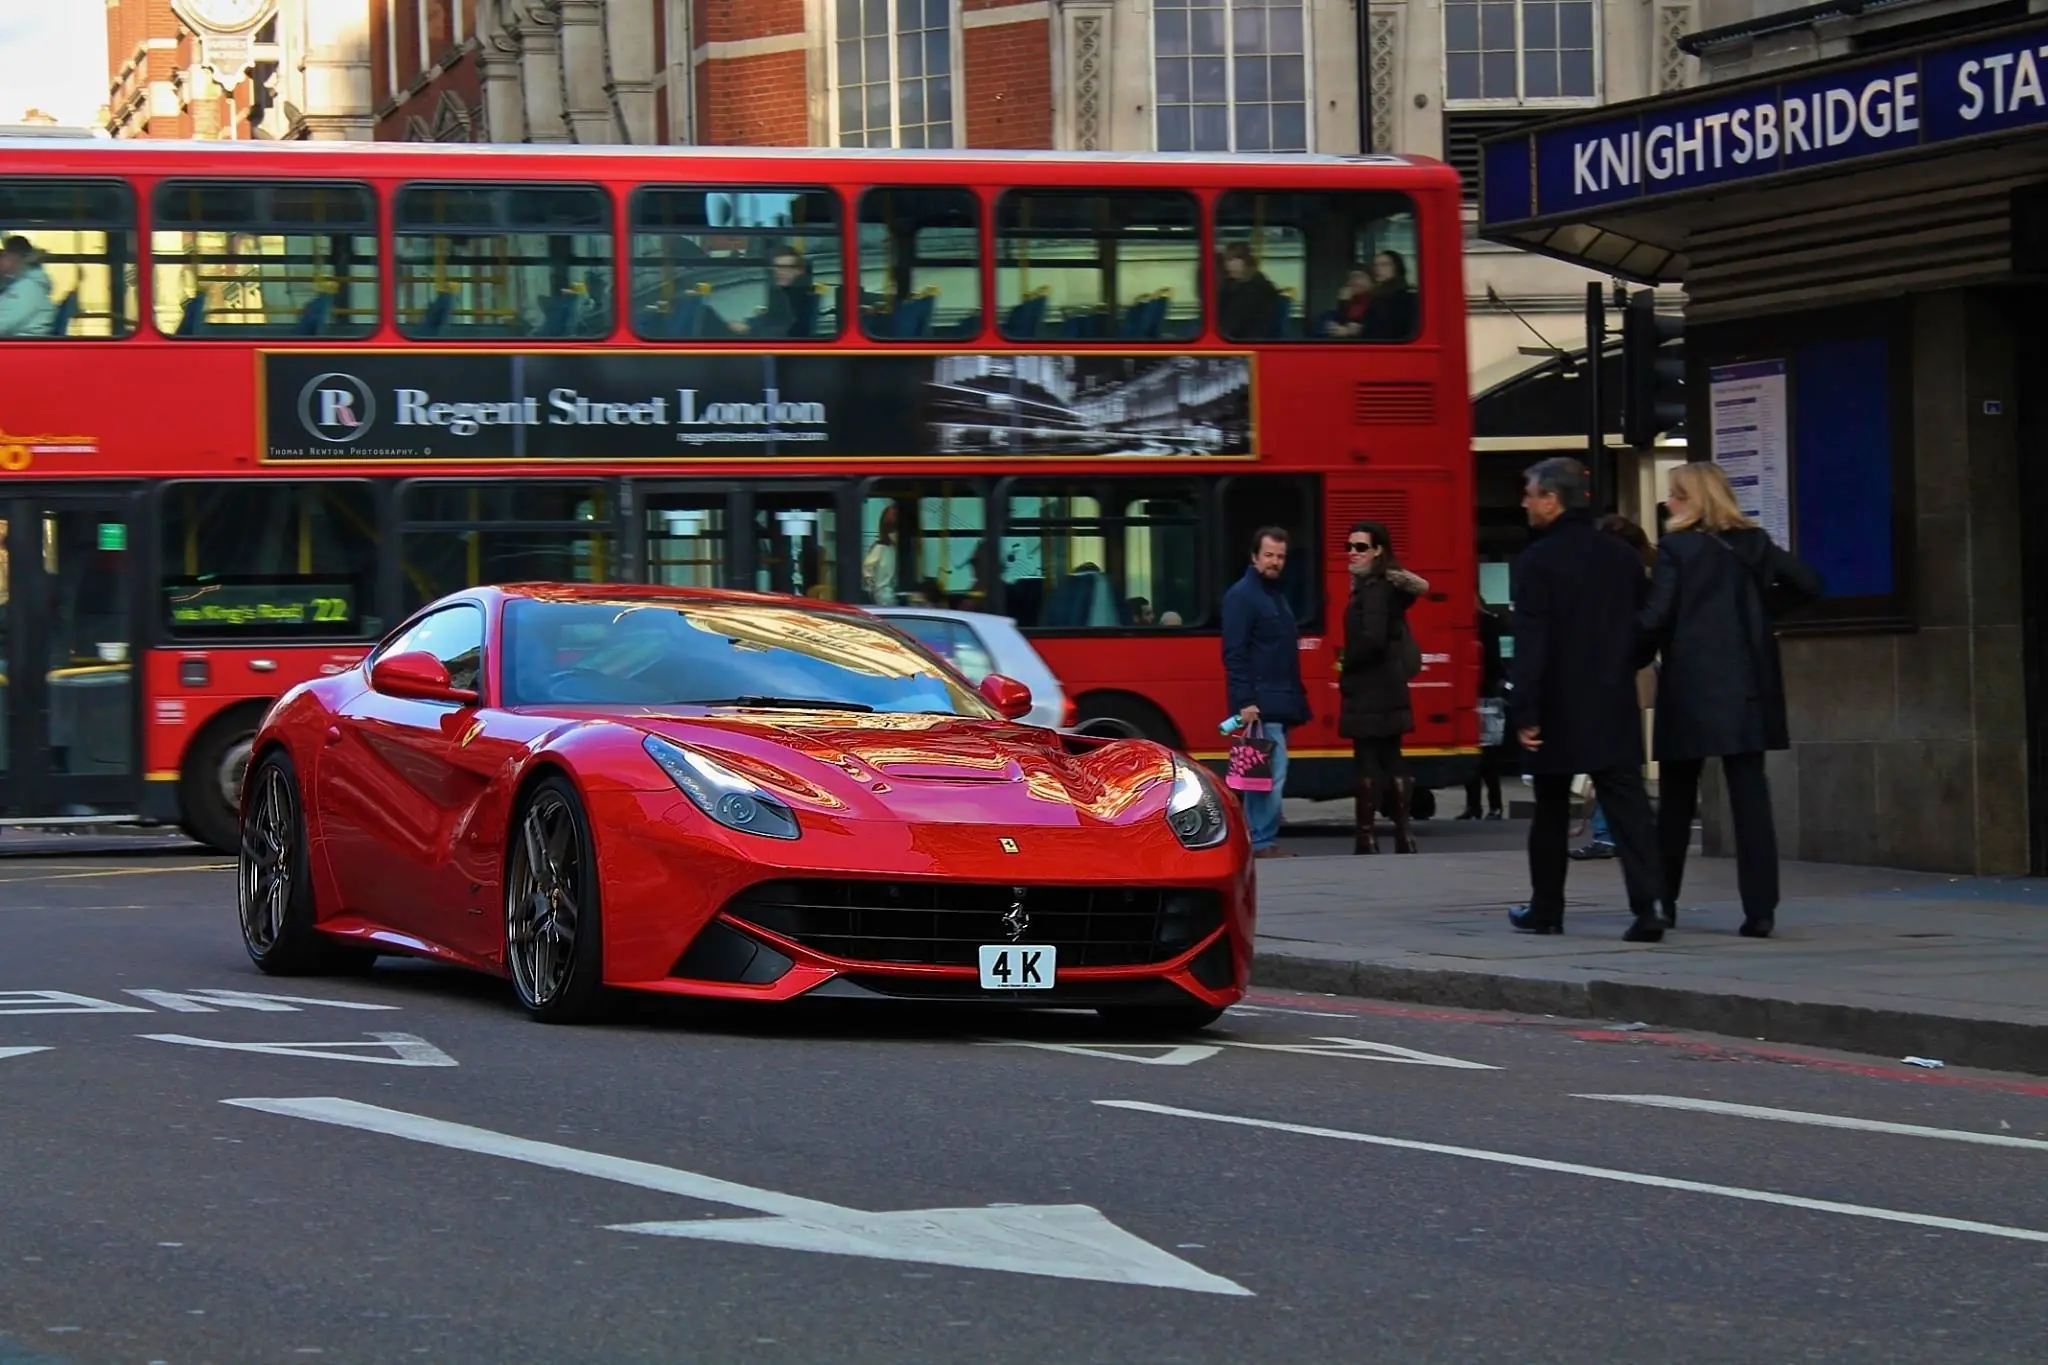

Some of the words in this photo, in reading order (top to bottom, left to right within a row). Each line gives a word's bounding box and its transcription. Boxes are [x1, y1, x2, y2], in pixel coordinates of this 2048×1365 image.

[1574, 72, 1920, 195] KNIGHTSBRIDGE
[393, 389, 542, 436] Regent
[548, 388, 670, 425] Street
[676, 388, 829, 425] London
[311, 598, 350, 622] 22
[991, 951, 1013, 983] 4
[1021, 951, 1042, 983] K
